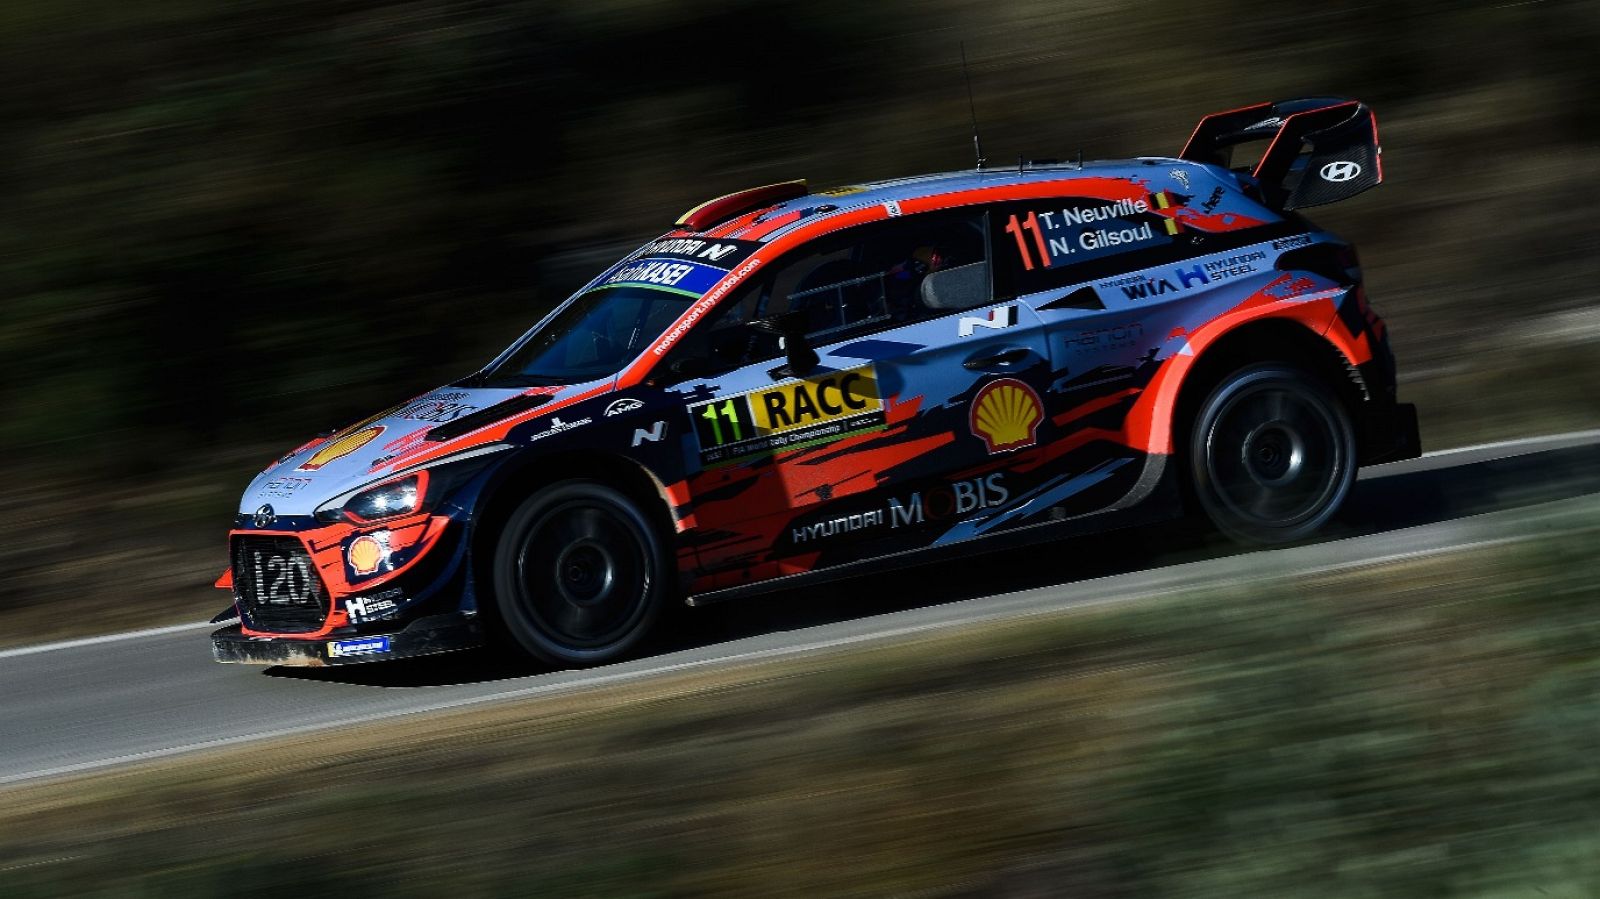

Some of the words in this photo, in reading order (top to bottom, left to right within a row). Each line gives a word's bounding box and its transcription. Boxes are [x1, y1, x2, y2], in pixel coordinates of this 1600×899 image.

[1038, 211, 1060, 229] T.
[1063, 198, 1148, 226] Neuville
[1006, 211, 1051, 270] 11
[1050, 237, 1075, 256] N.
[1079, 222, 1153, 250] Gilsoul
[1204, 251, 1266, 271] HYUNDAI
[1210, 265, 1258, 281] STEEL
[653, 258, 762, 355] motorsport.hyundai.com
[702, 399, 742, 446] 11
[763, 373, 867, 429] RACC
[793, 509, 884, 543] HYUNDAI
[887, 472, 1010, 529] MOBIS
